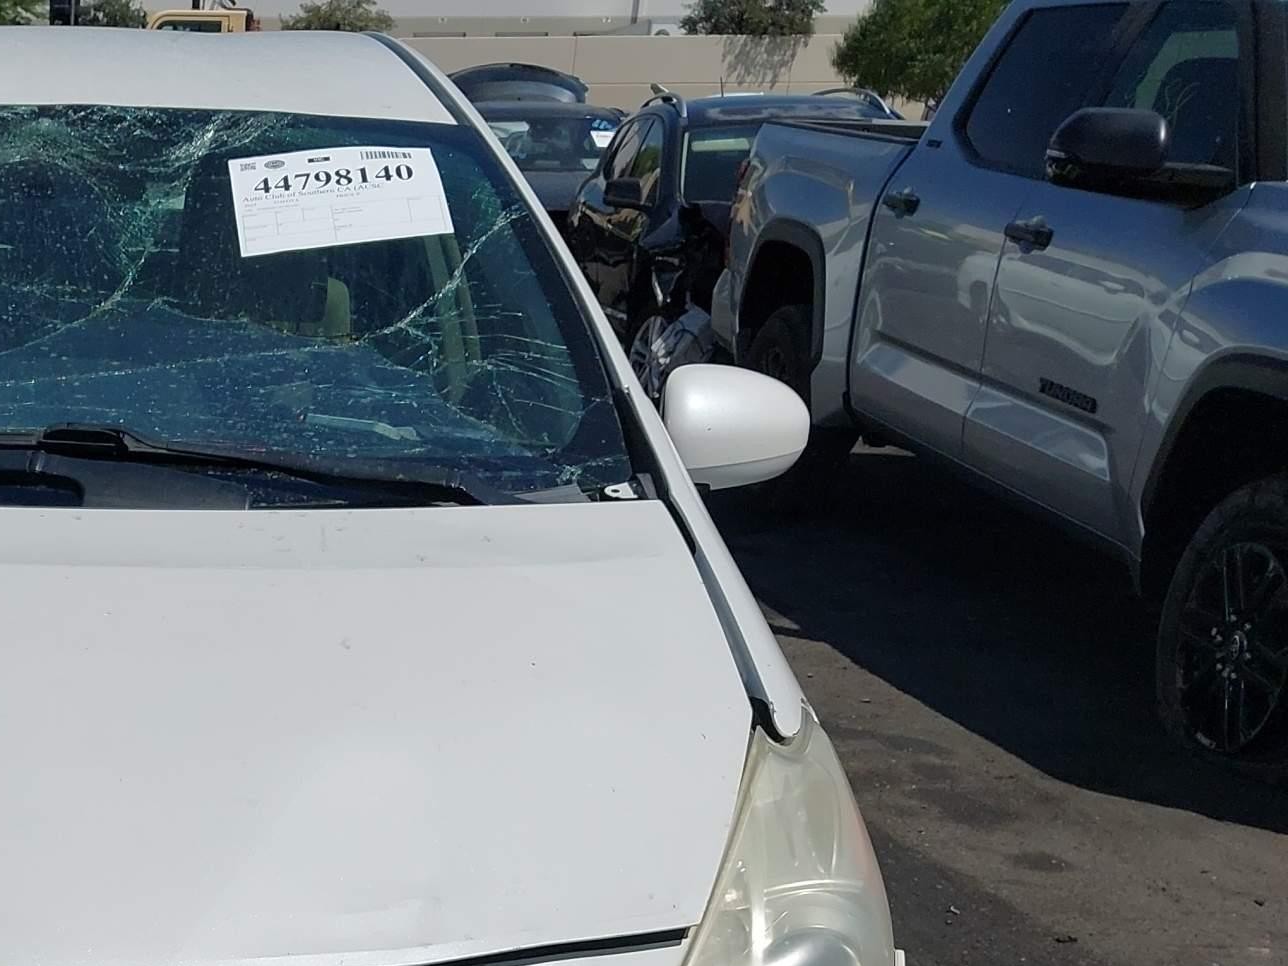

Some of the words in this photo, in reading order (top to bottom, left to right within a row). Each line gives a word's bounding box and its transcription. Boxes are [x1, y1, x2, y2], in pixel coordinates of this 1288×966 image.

[254, 164, 413, 193] 44798140
[242, 195, 263, 203] Auto
[264, 192, 285, 201] Club
[287, 190, 296, 198] of
[298, 187, 336, 198] Southern
